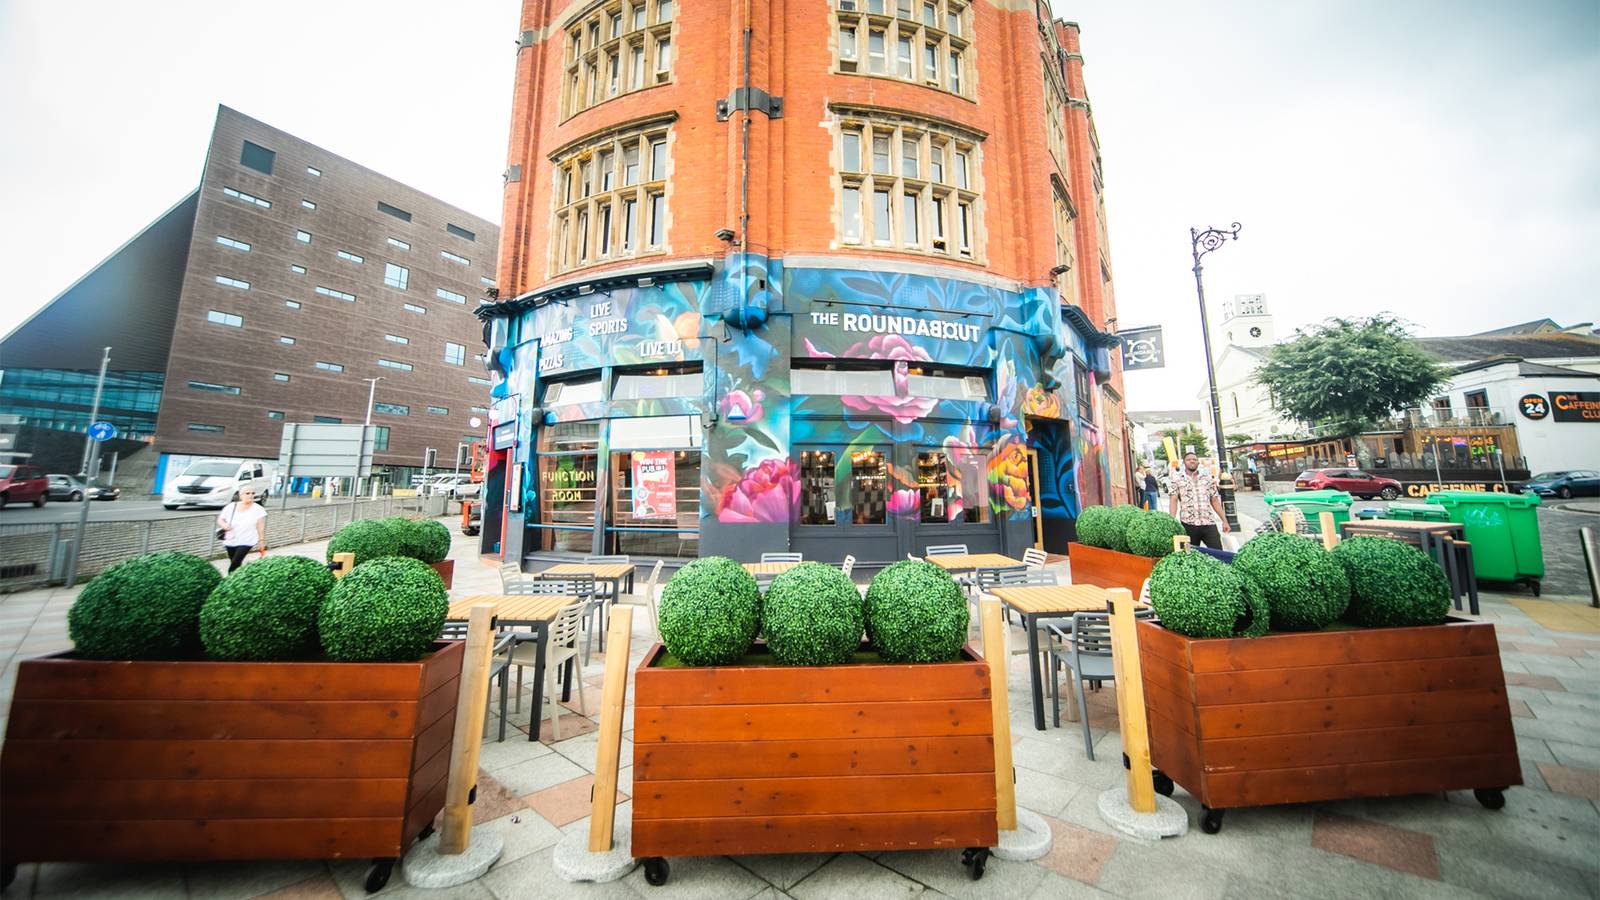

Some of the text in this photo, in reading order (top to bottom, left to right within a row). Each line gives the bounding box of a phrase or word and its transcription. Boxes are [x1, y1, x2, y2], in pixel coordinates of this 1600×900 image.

[590, 302, 611, 318] LIVE
[588, 319, 628, 336] SPORTS
[811, 312, 981, 343] THE ROUNDABOUT
[540, 328, 573, 347] AMAZING
[640, 340, 666, 357] LIVE
[539, 354, 564, 371] PIZZAS
[1525, 403, 1546, 414] 24
[542, 470, 595, 482] FUNCTION
[552, 490, 581, 501] ROOM
